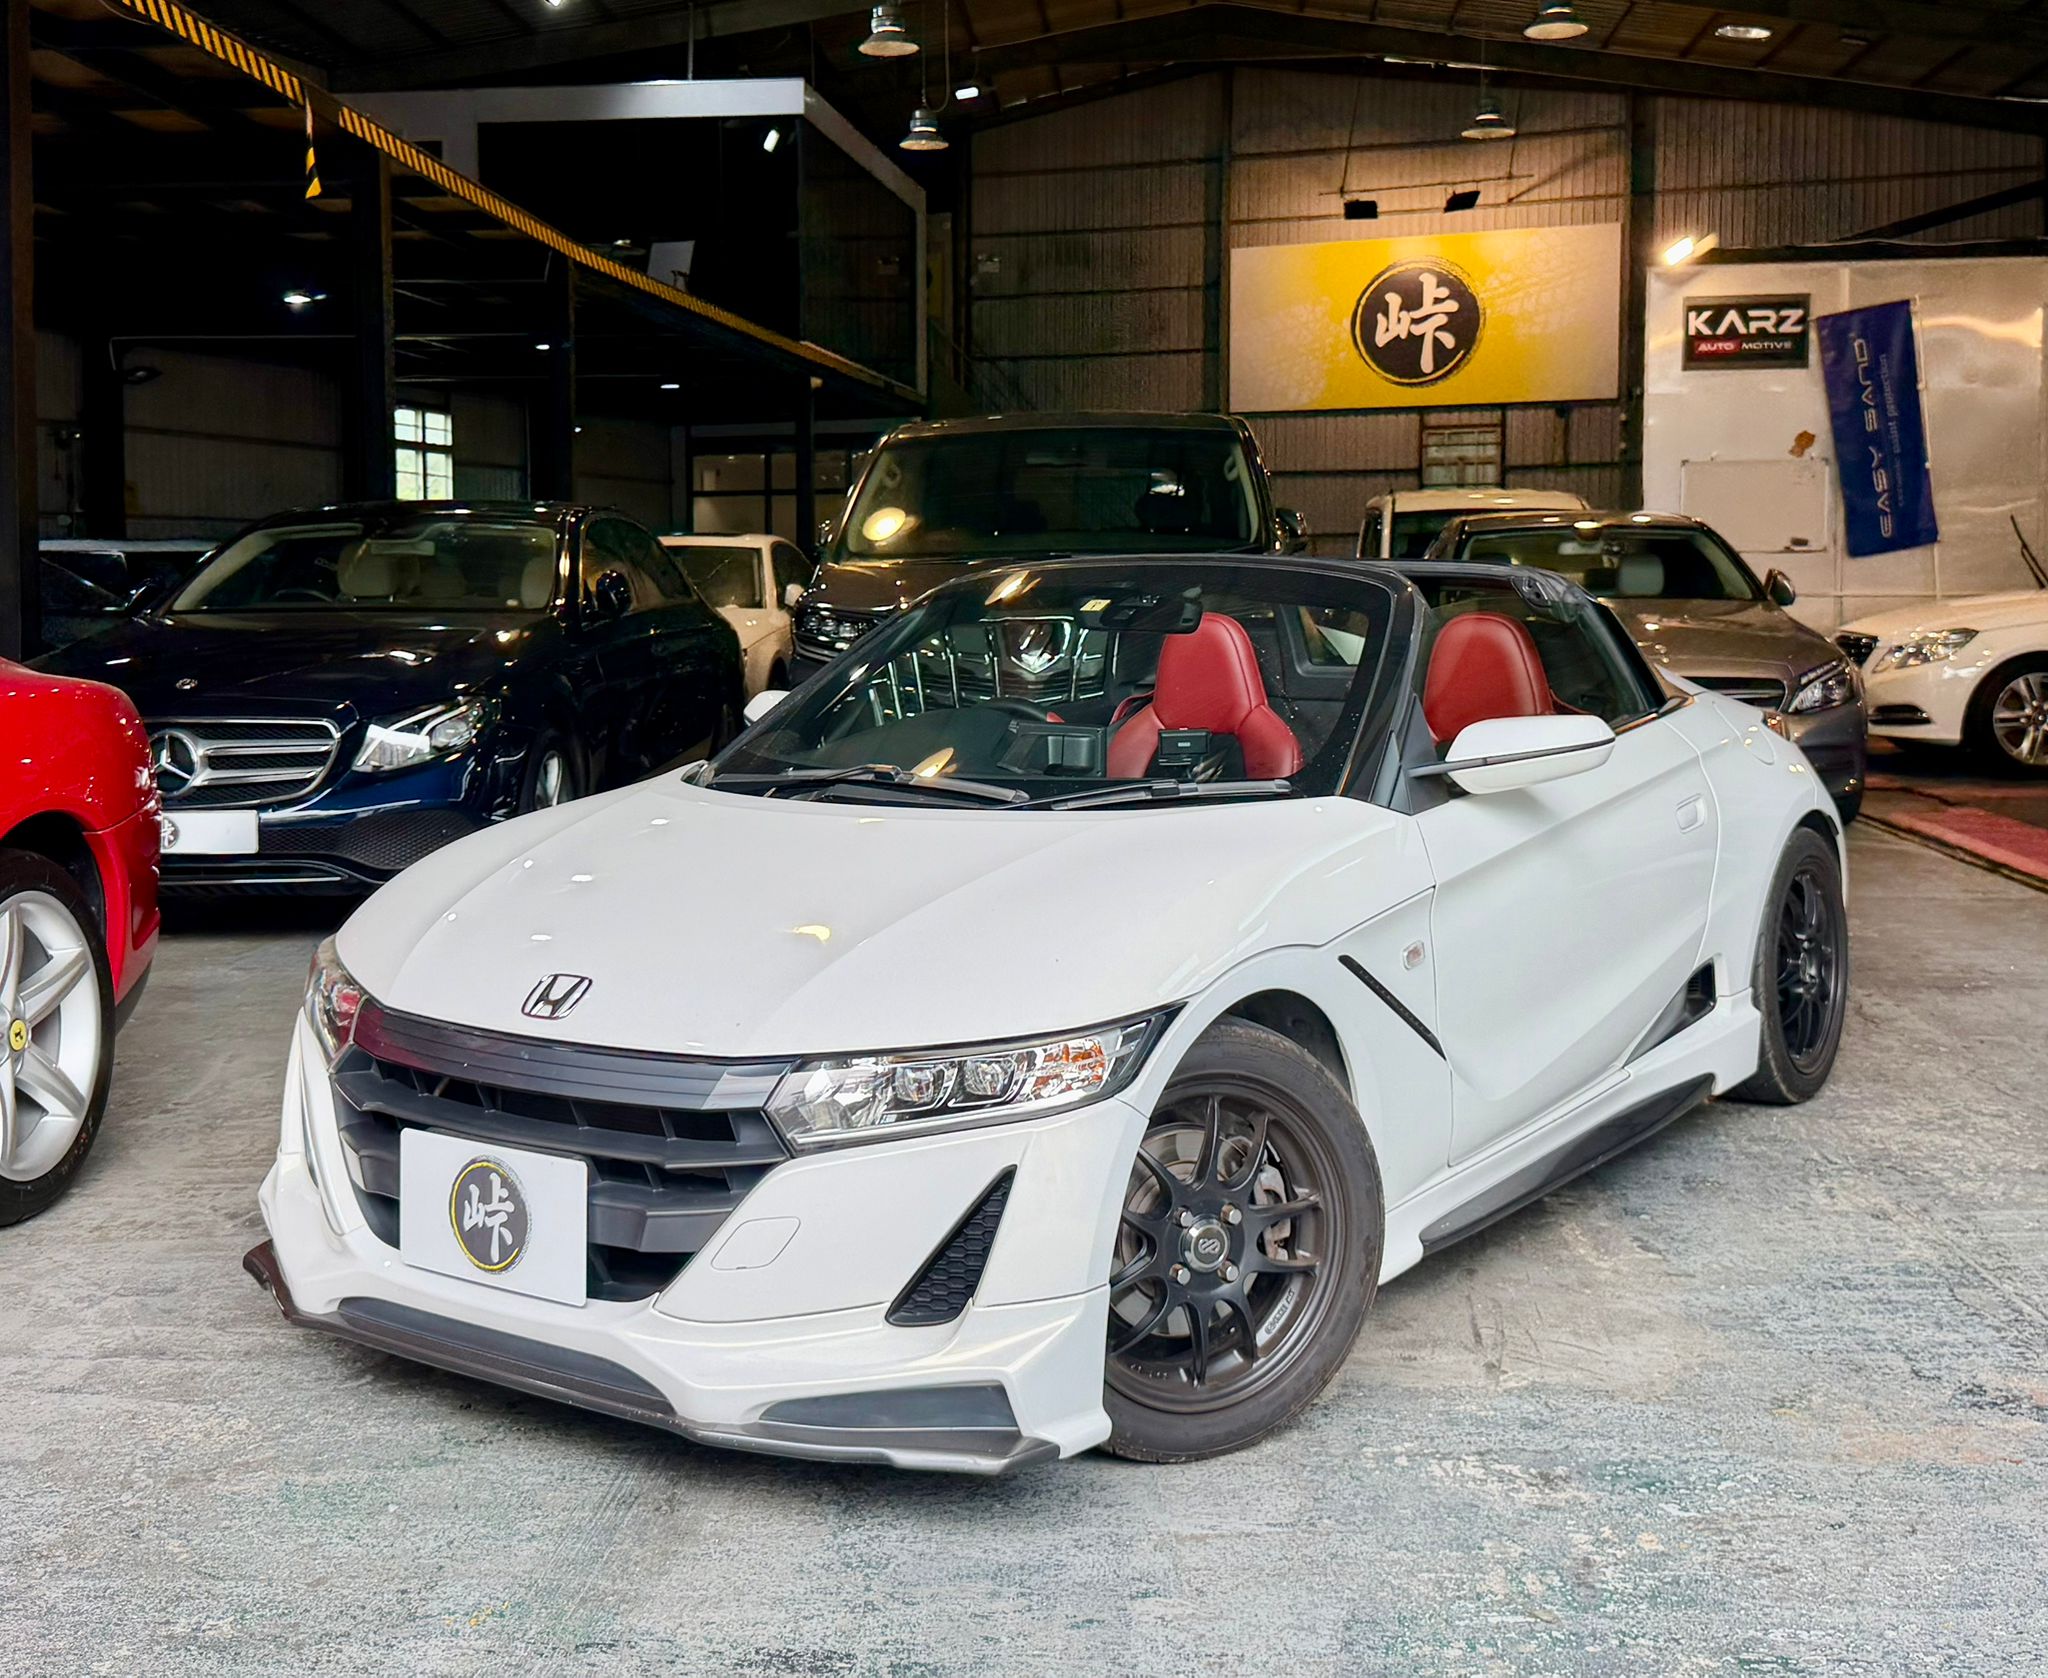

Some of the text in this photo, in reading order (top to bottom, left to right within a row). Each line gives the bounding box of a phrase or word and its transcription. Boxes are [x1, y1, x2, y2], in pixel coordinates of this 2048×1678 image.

[1374, 272, 1459, 374] 峠
[1688, 309, 1804, 336] KARZ
[1698, 341, 1792, 351] AUTO MOTIVE
[1880, 353, 1899, 417] protection
[1868, 446, 1892, 538] EASY
[462, 1172, 515, 1263] 峠
